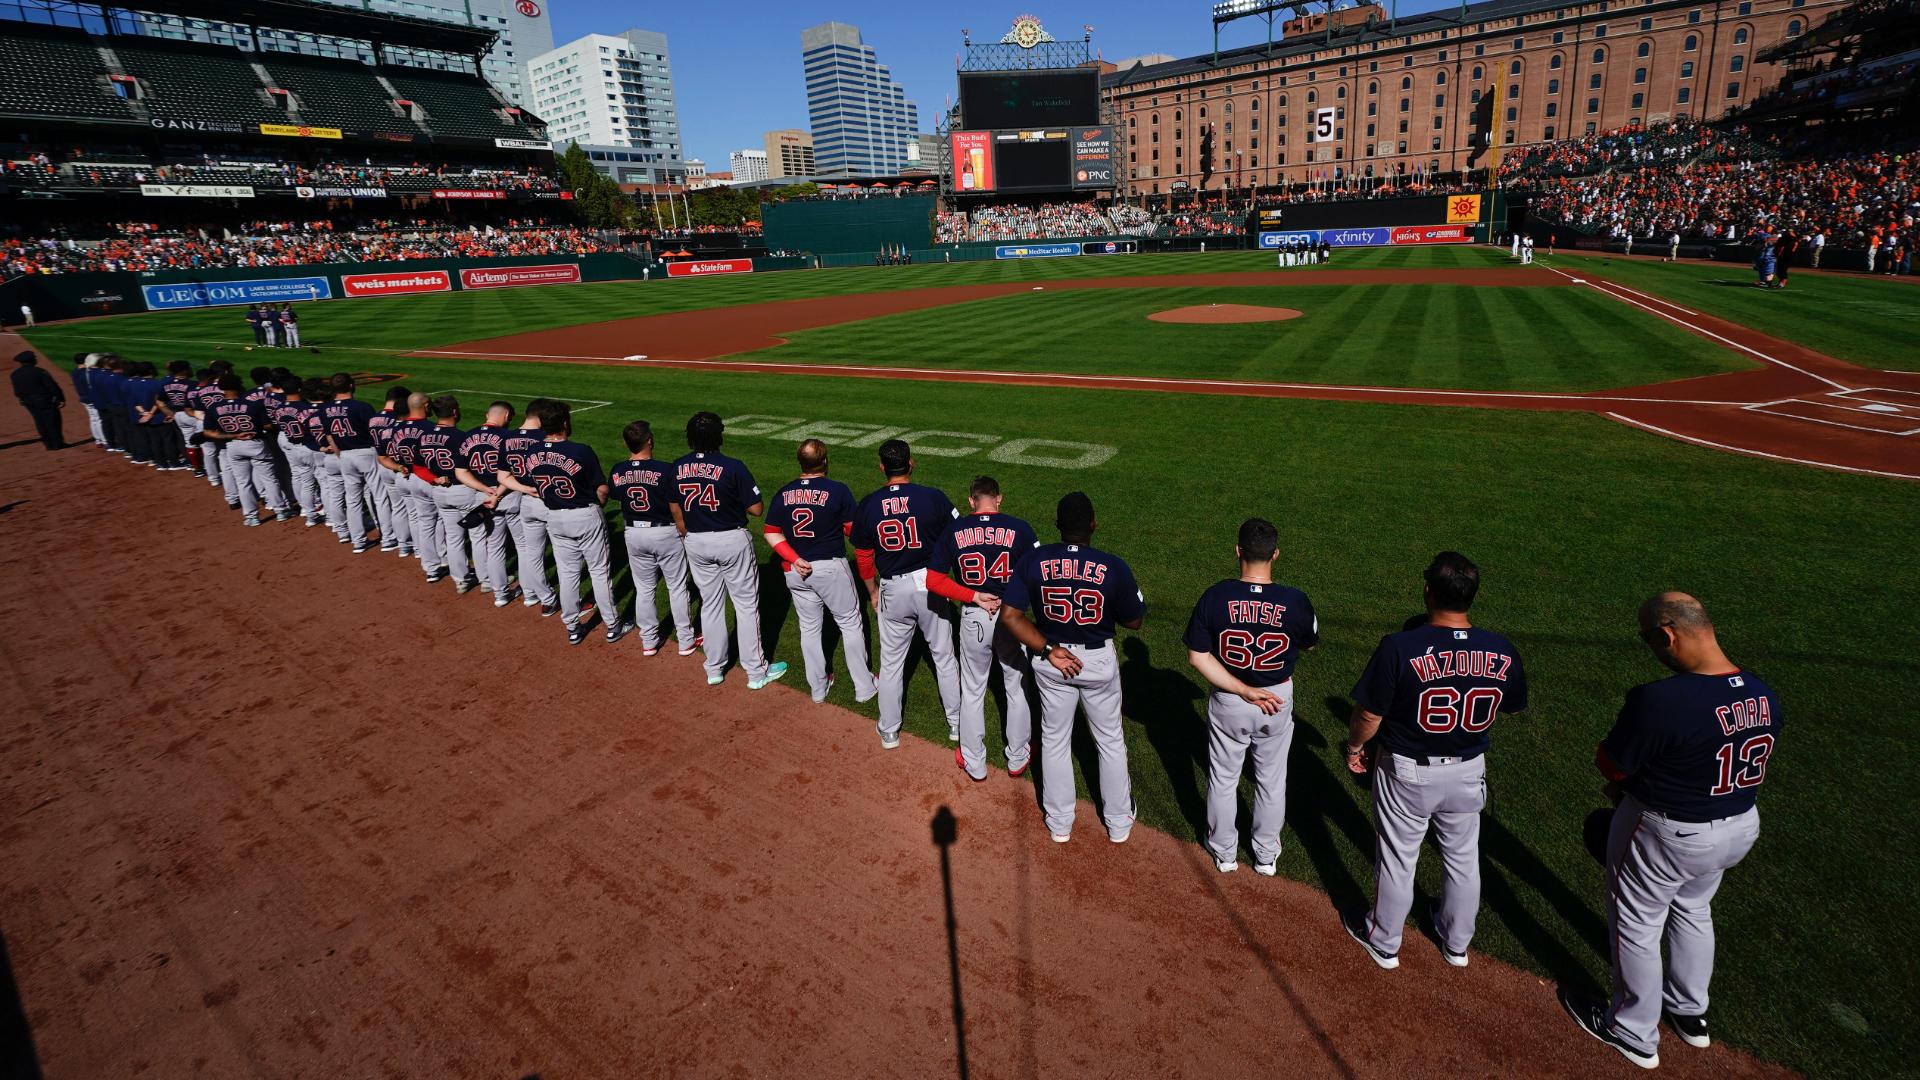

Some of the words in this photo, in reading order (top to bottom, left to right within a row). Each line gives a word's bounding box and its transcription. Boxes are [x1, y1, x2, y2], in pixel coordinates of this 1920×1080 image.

[151, 118, 207, 131] GANZ
[1317, 111, 1332, 137] 5
[501, 139, 524, 147] WBAL
[1089, 171, 1110, 180] PNC
[351, 187, 387, 197] UNION
[1264, 234, 1310, 245] GEICO
[1335, 230, 1375, 244] xfinity
[1396, 232, 1420, 242] HIGH'S
[352, 279, 385, 289] weis
[387, 276, 442, 288] markets
[470, 272, 508, 284] Airtemp
[325, 406, 349, 418] SALE
[217, 415, 254, 433] 66
[330, 417, 357, 438] 41
[420, 434, 450, 447] KELLY
[721, 414, 1119, 470] GEICO
[419, 448, 455, 470] 76
[612, 469, 662, 487] McGUIRE
[676, 463, 724, 481] JANSEN
[532, 475, 577, 499] 73
[678, 483, 720, 512] 74
[781, 489, 829, 507] TURNER
[626, 486, 650, 512] 3
[881, 496, 909, 516] FOX
[791, 507, 815, 538] 2
[876, 516, 922, 552] 81
[954, 526, 1016, 550] HUDSON
[957, 551, 1014, 587] 84
[1040, 558, 1108, 585] FEBLES
[1041, 585, 1105, 626] 53
[1227, 600, 1286, 628] FATSE
[1219, 628, 1290, 672] 62
[1409, 645, 1512, 683] VÁZQUEZ
[1416, 686, 1503, 734] 60
[1715, 696, 1771, 737] CORA
[1710, 733, 1775, 796] 13
